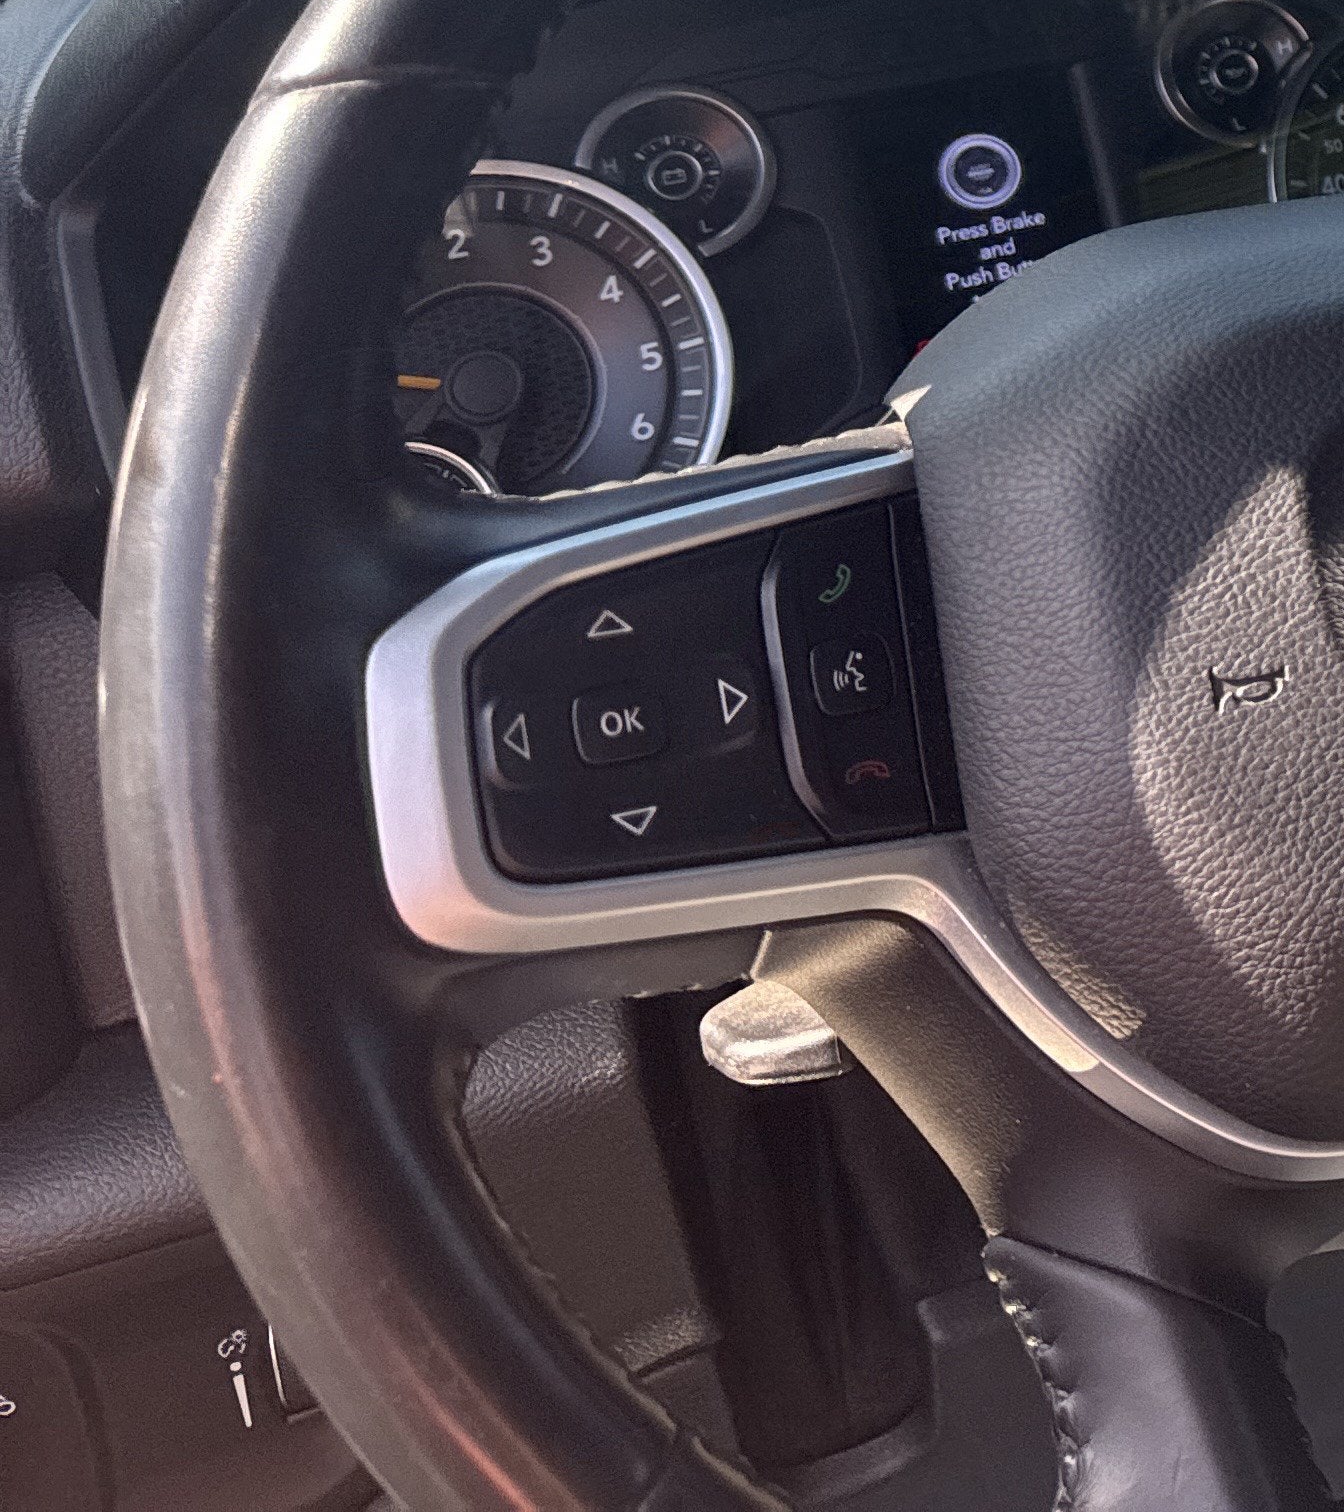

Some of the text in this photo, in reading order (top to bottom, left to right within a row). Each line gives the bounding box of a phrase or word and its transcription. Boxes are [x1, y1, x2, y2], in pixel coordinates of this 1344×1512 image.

[936, 211, 1046, 245] Press Brake
[448, 228, 470, 259] 2
[529, 236, 553, 266] 3
[978, 238, 1017, 261] and
[600, 275, 624, 303] 4
[944, 266, 995, 291] Push
[639, 341, 663, 371] 5
[631, 413, 655, 440] 6
[600, 706, 644, 736] OK
